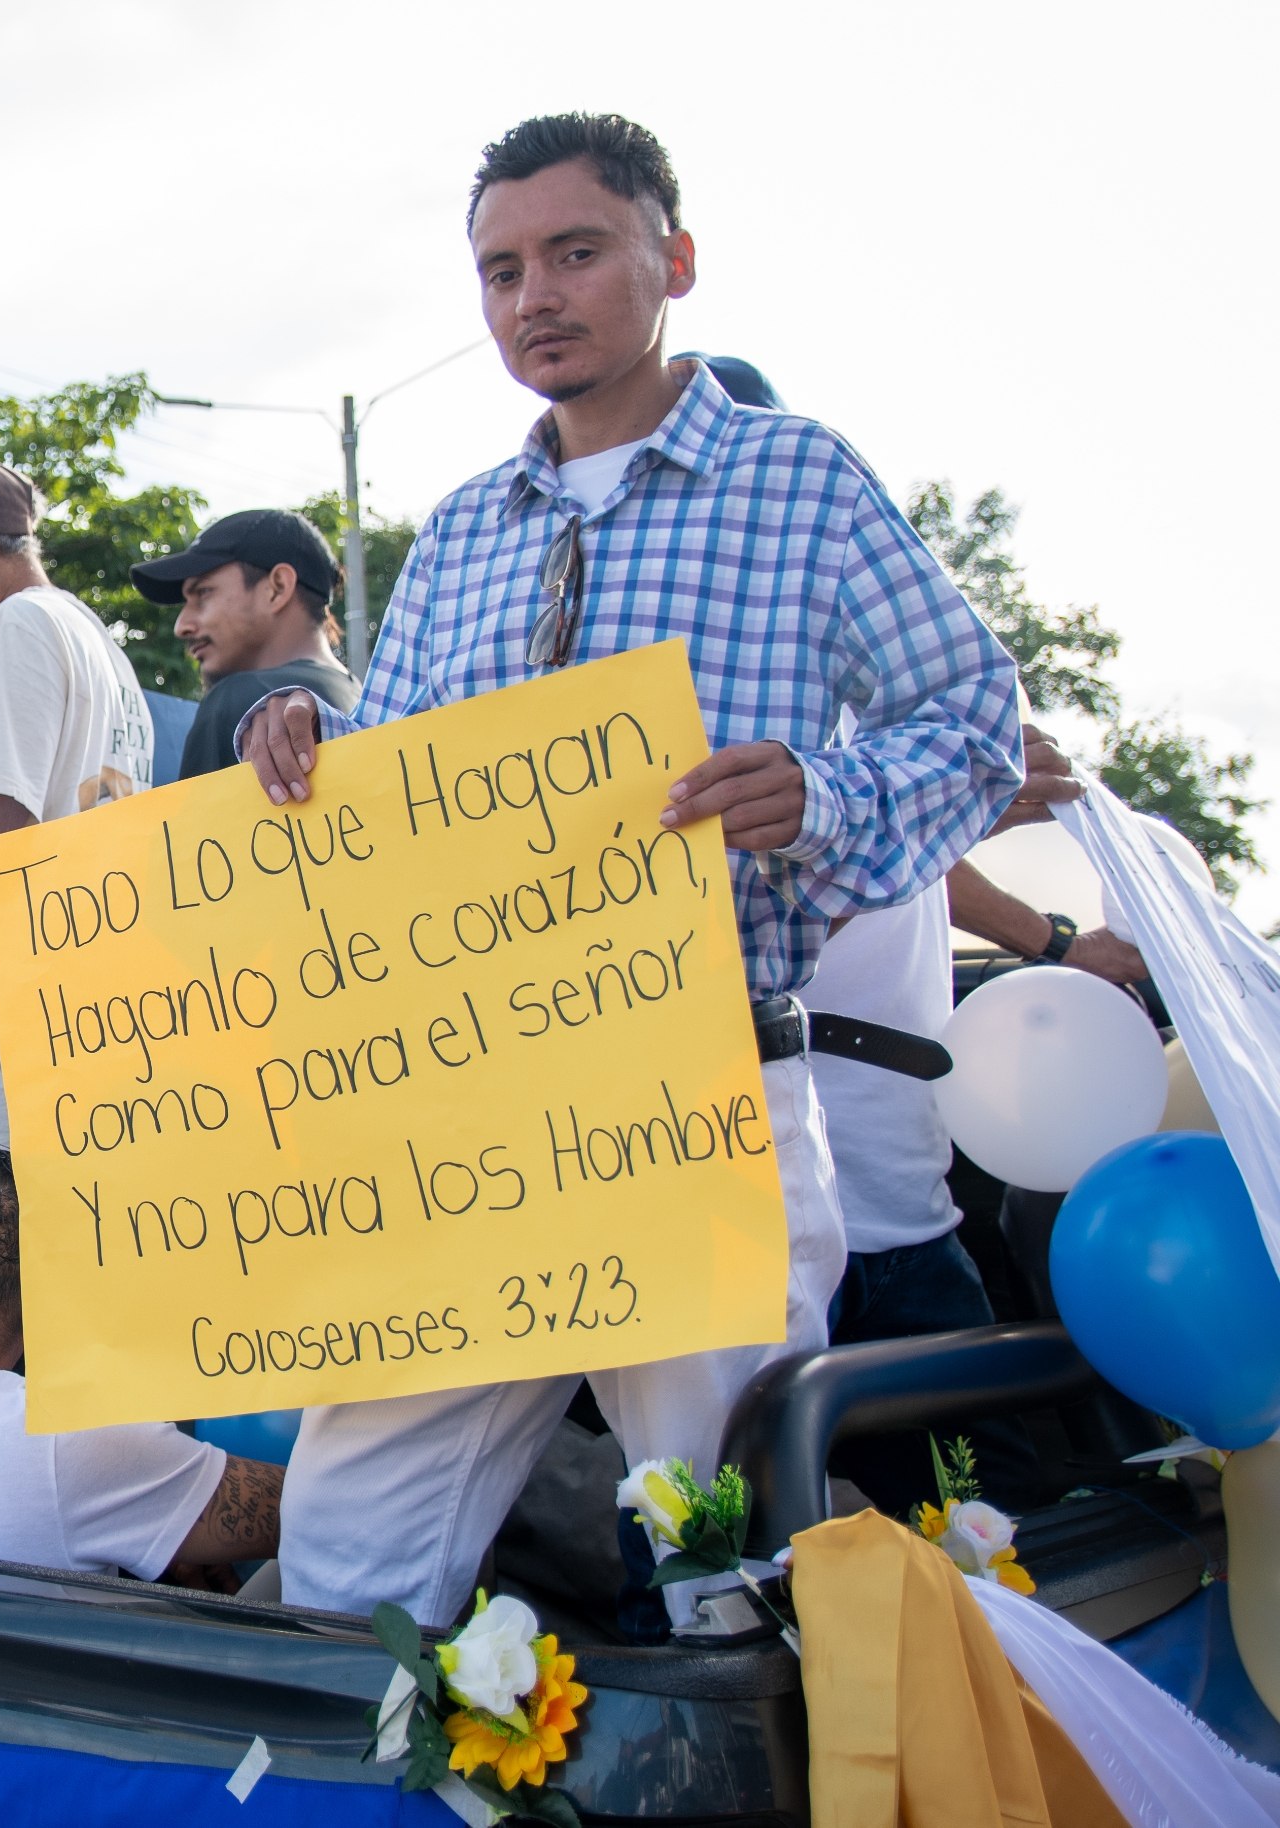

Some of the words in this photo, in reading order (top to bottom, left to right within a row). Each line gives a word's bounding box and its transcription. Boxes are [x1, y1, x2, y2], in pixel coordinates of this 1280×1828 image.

[162, 820, 234, 911] Lo
[251, 804, 374, 912] que
[397, 712, 670, 855] Hagan,
[38, 946, 277, 1083] Haganlo
[299, 908, 389, 999] de
[408, 821, 707, 969] corazón,
[255, 1027, 410, 1151] para
[427, 991, 488, 1067] el
[127, 1195, 208, 1257] no
[227, 1175, 384, 1276] para
[406, 1139, 526, 1221] los
